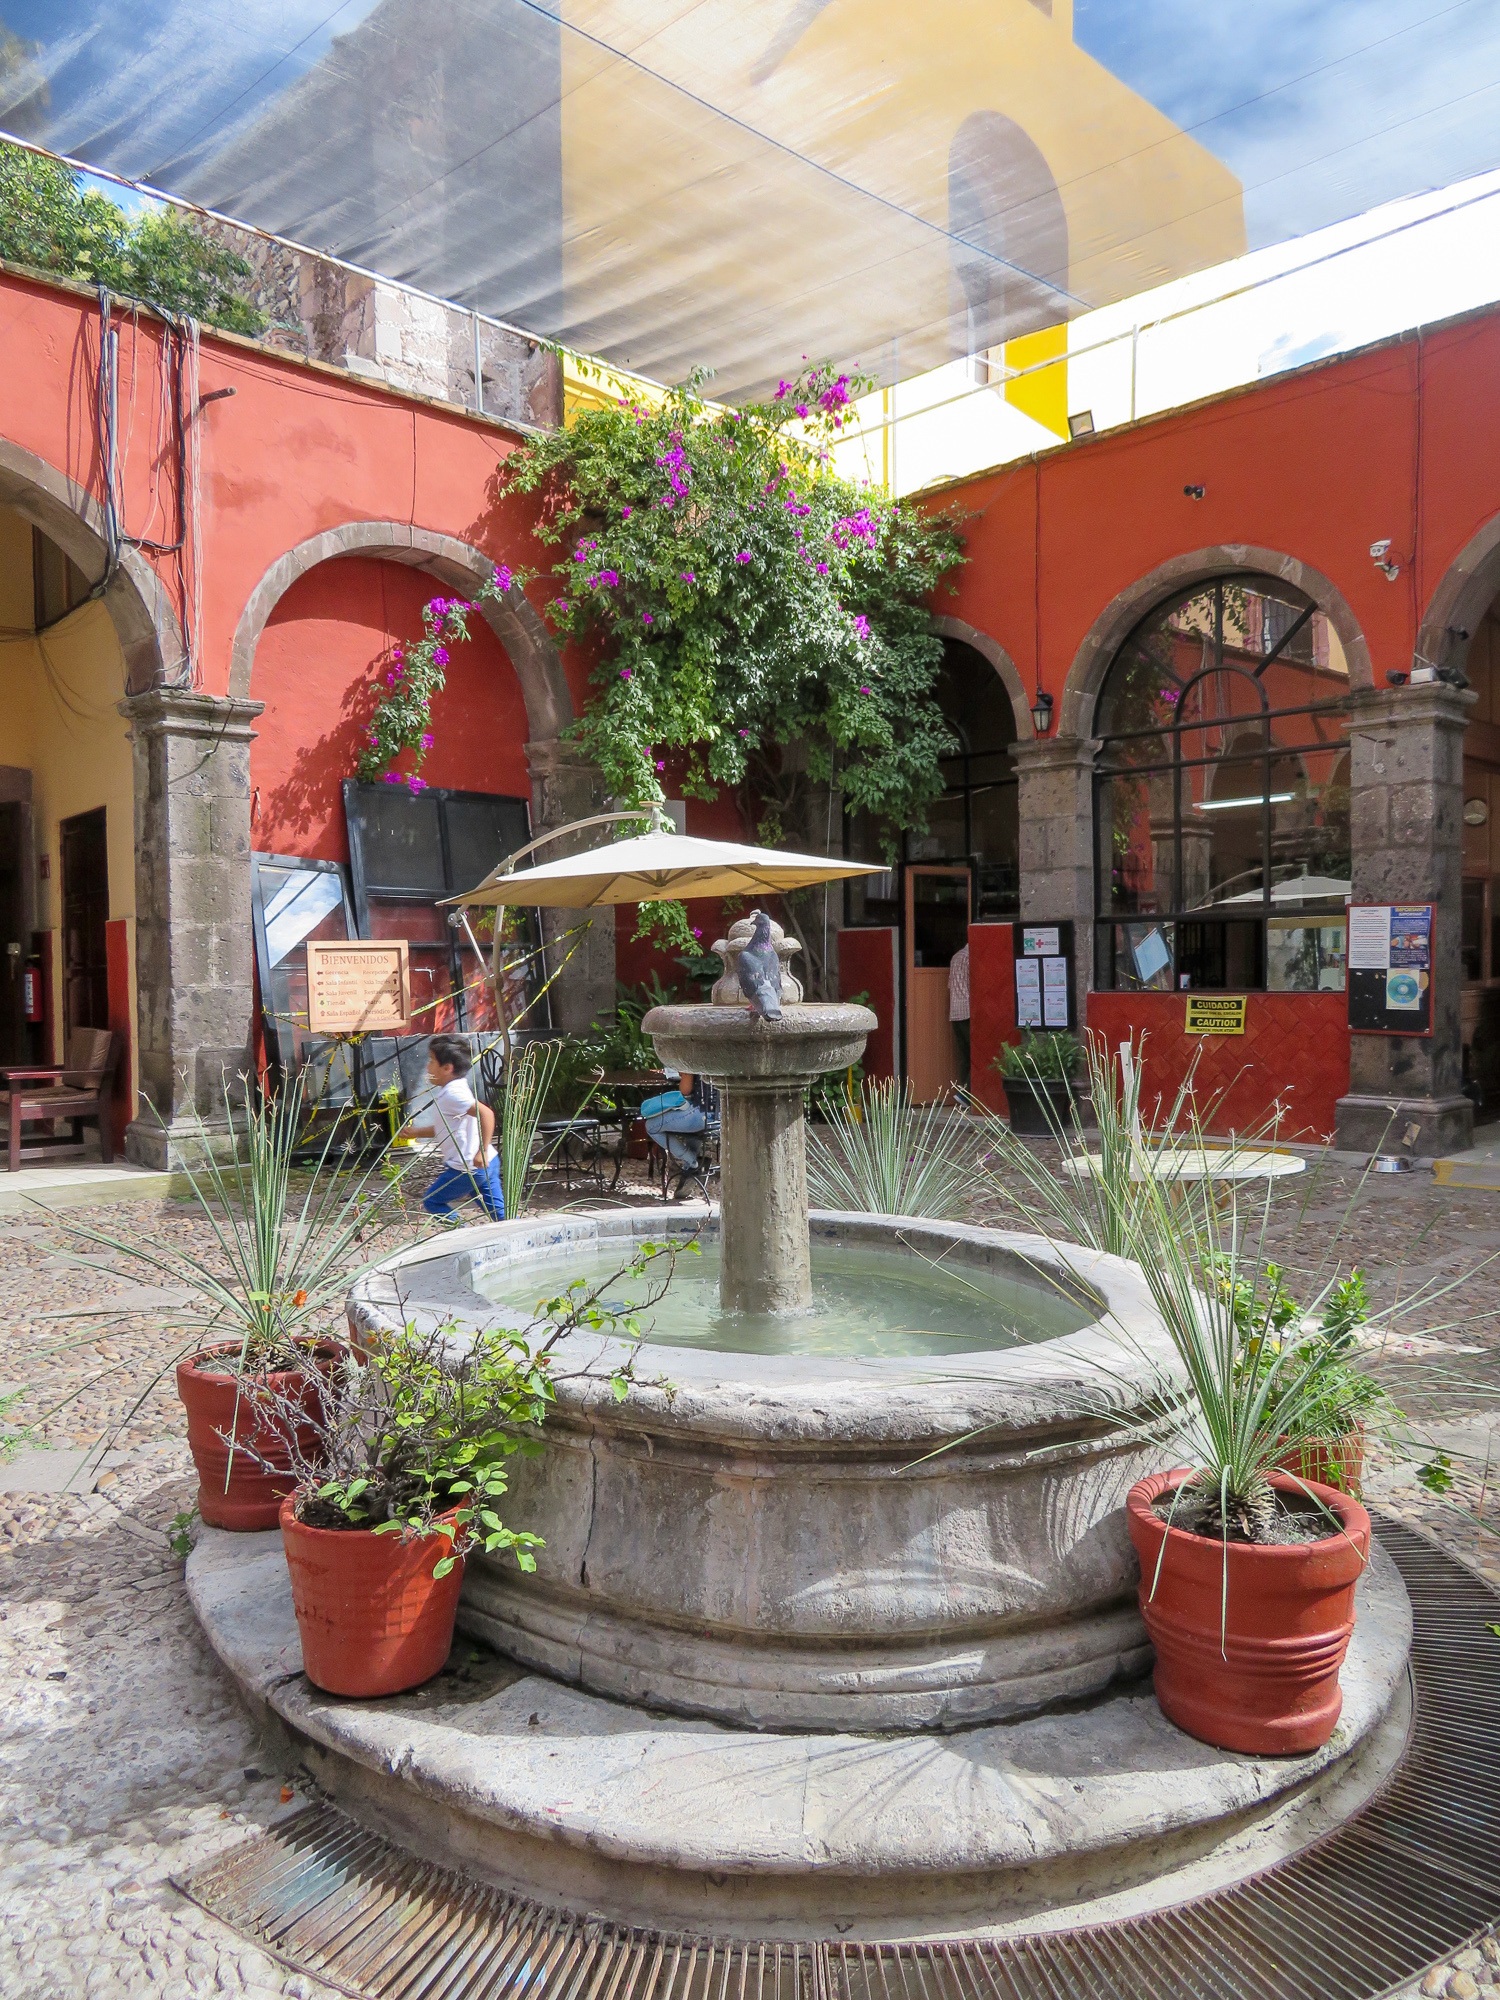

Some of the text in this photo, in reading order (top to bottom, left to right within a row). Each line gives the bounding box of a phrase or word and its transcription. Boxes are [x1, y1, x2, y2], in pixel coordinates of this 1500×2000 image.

[321, 954, 389, 965] BIENVENIDOS
[1196, 1001, 1237, 1009] CUIDADO
[1196, 1018, 1237, 1027] CAUTION
